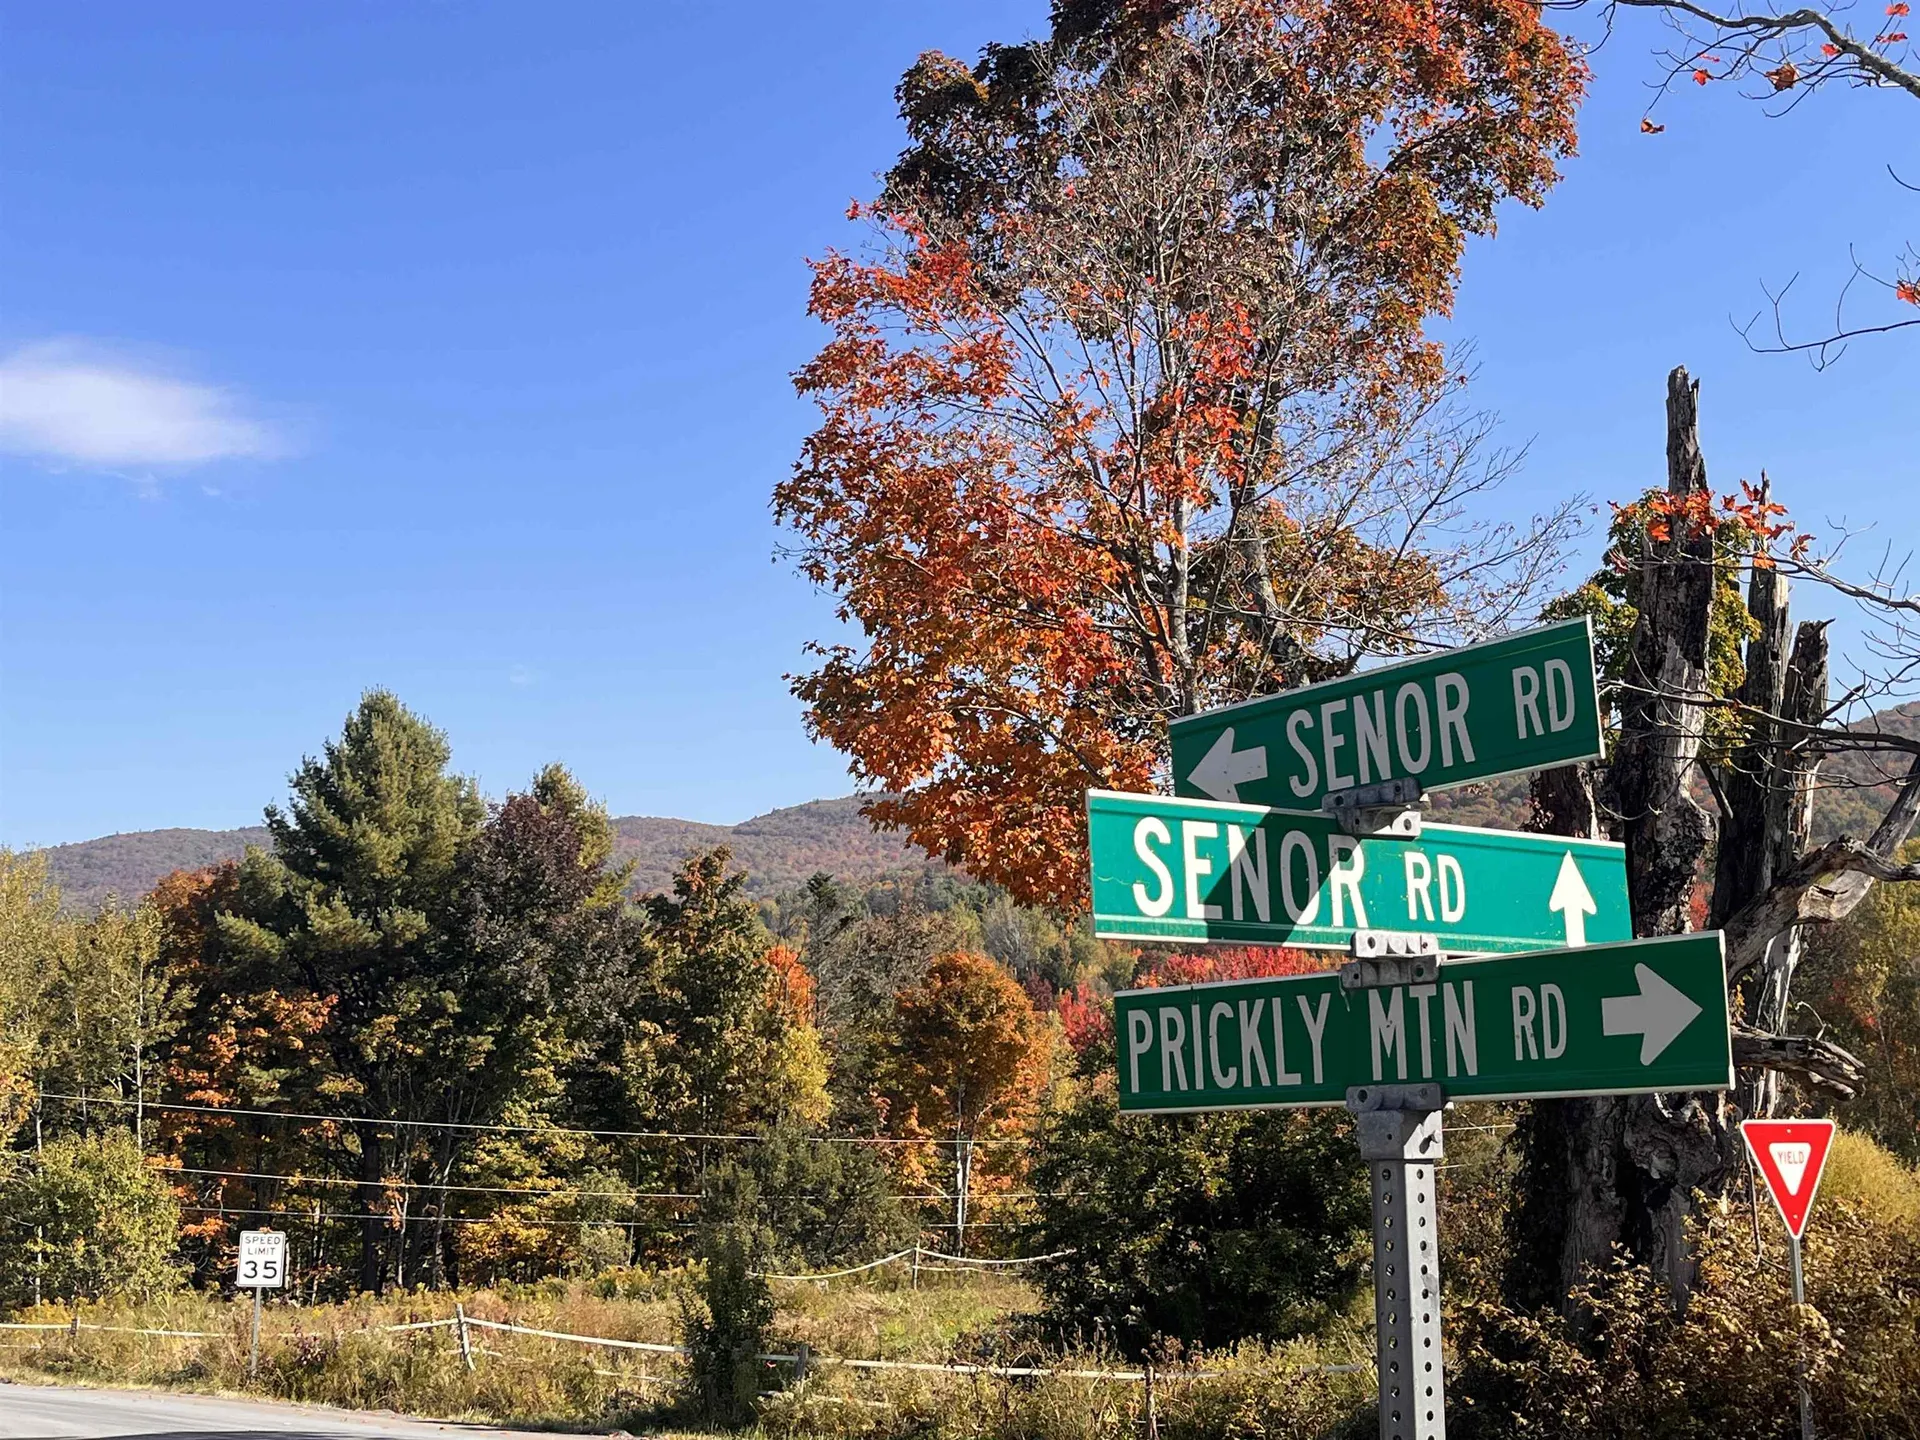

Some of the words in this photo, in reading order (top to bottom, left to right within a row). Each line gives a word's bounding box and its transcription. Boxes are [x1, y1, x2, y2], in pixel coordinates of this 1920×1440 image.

[1286, 671, 1476, 798] SENOR
[1512, 658, 1576, 740] RD
[1132, 816, 1369, 928] SENOR
[1404, 851, 1466, 924] RD
[1127, 993, 1331, 1094] PRICKLY
[1368, 980, 1478, 1081] MTN
[1512, 983, 1567, 1061] RD
[1777, 1151, 1805, 1165] YIELD
[244, 1236, 281, 1245] SPEED
[247, 1247, 275, 1256] LIMIT
[243, 1260, 277, 1279] 35
